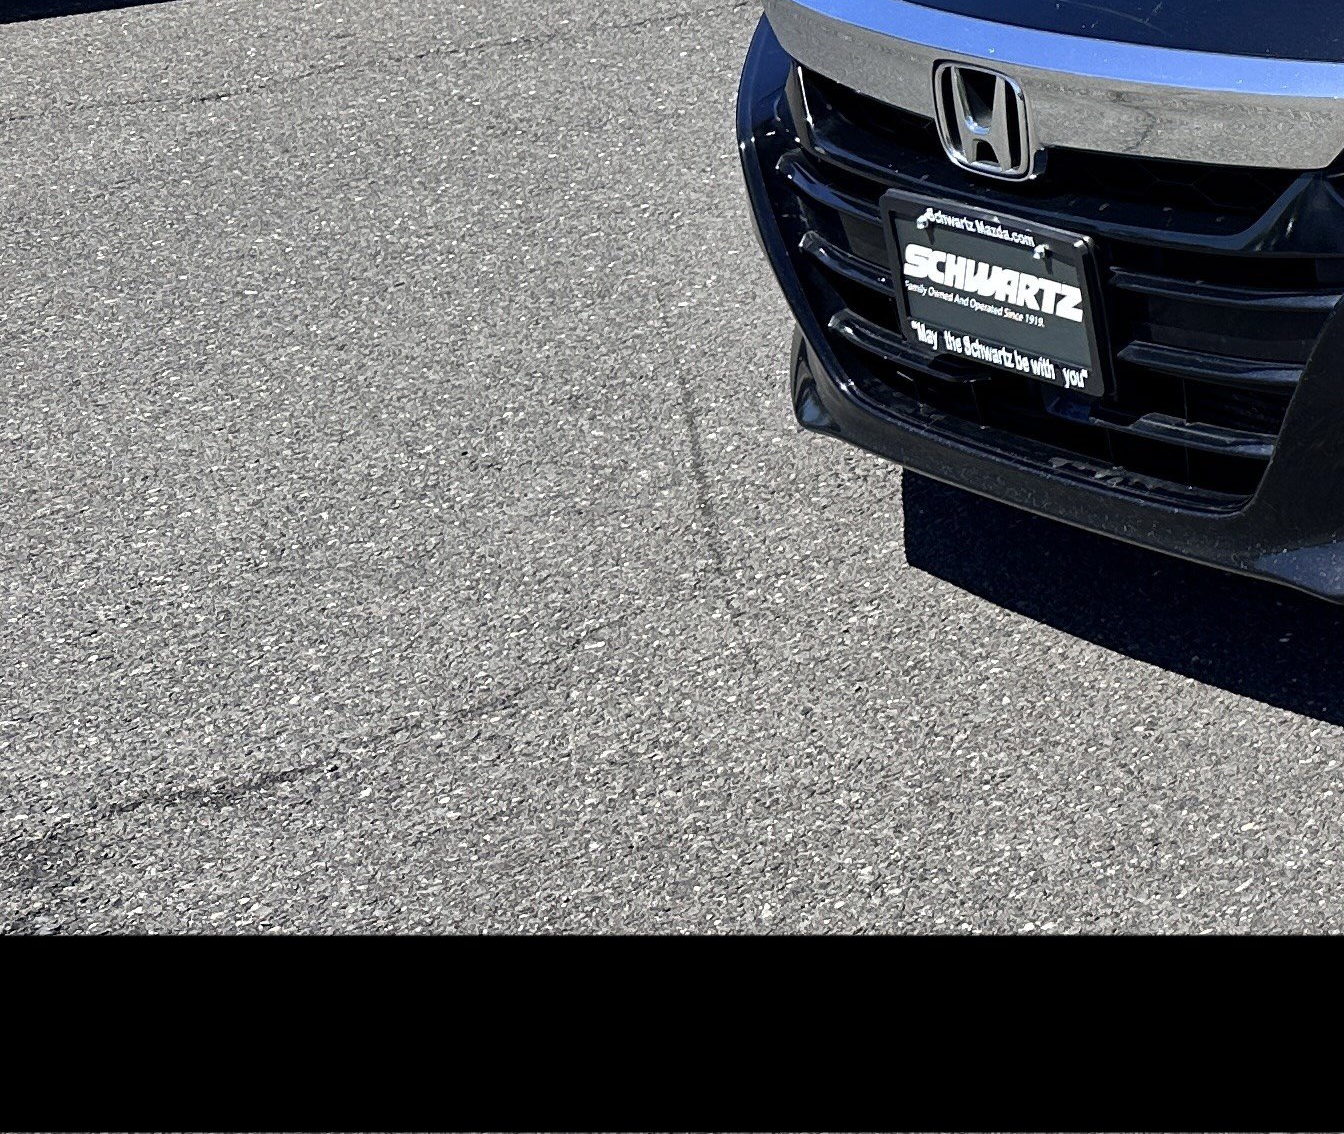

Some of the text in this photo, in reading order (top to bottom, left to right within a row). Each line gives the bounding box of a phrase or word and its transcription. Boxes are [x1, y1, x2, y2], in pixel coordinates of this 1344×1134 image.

[903, 243, 1084, 323] SCHWARTZ
[928, 286, 954, 303] Owned
[954, 293, 969, 307] And
[969, 298, 1004, 317] Operated
[1003, 307, 1024, 322] Since
[943, 330, 963, 354] the
[962, 335, 1015, 369] Schwartz
[1014, 349, 1030, 373] be
[1030, 356, 1056, 380] with
